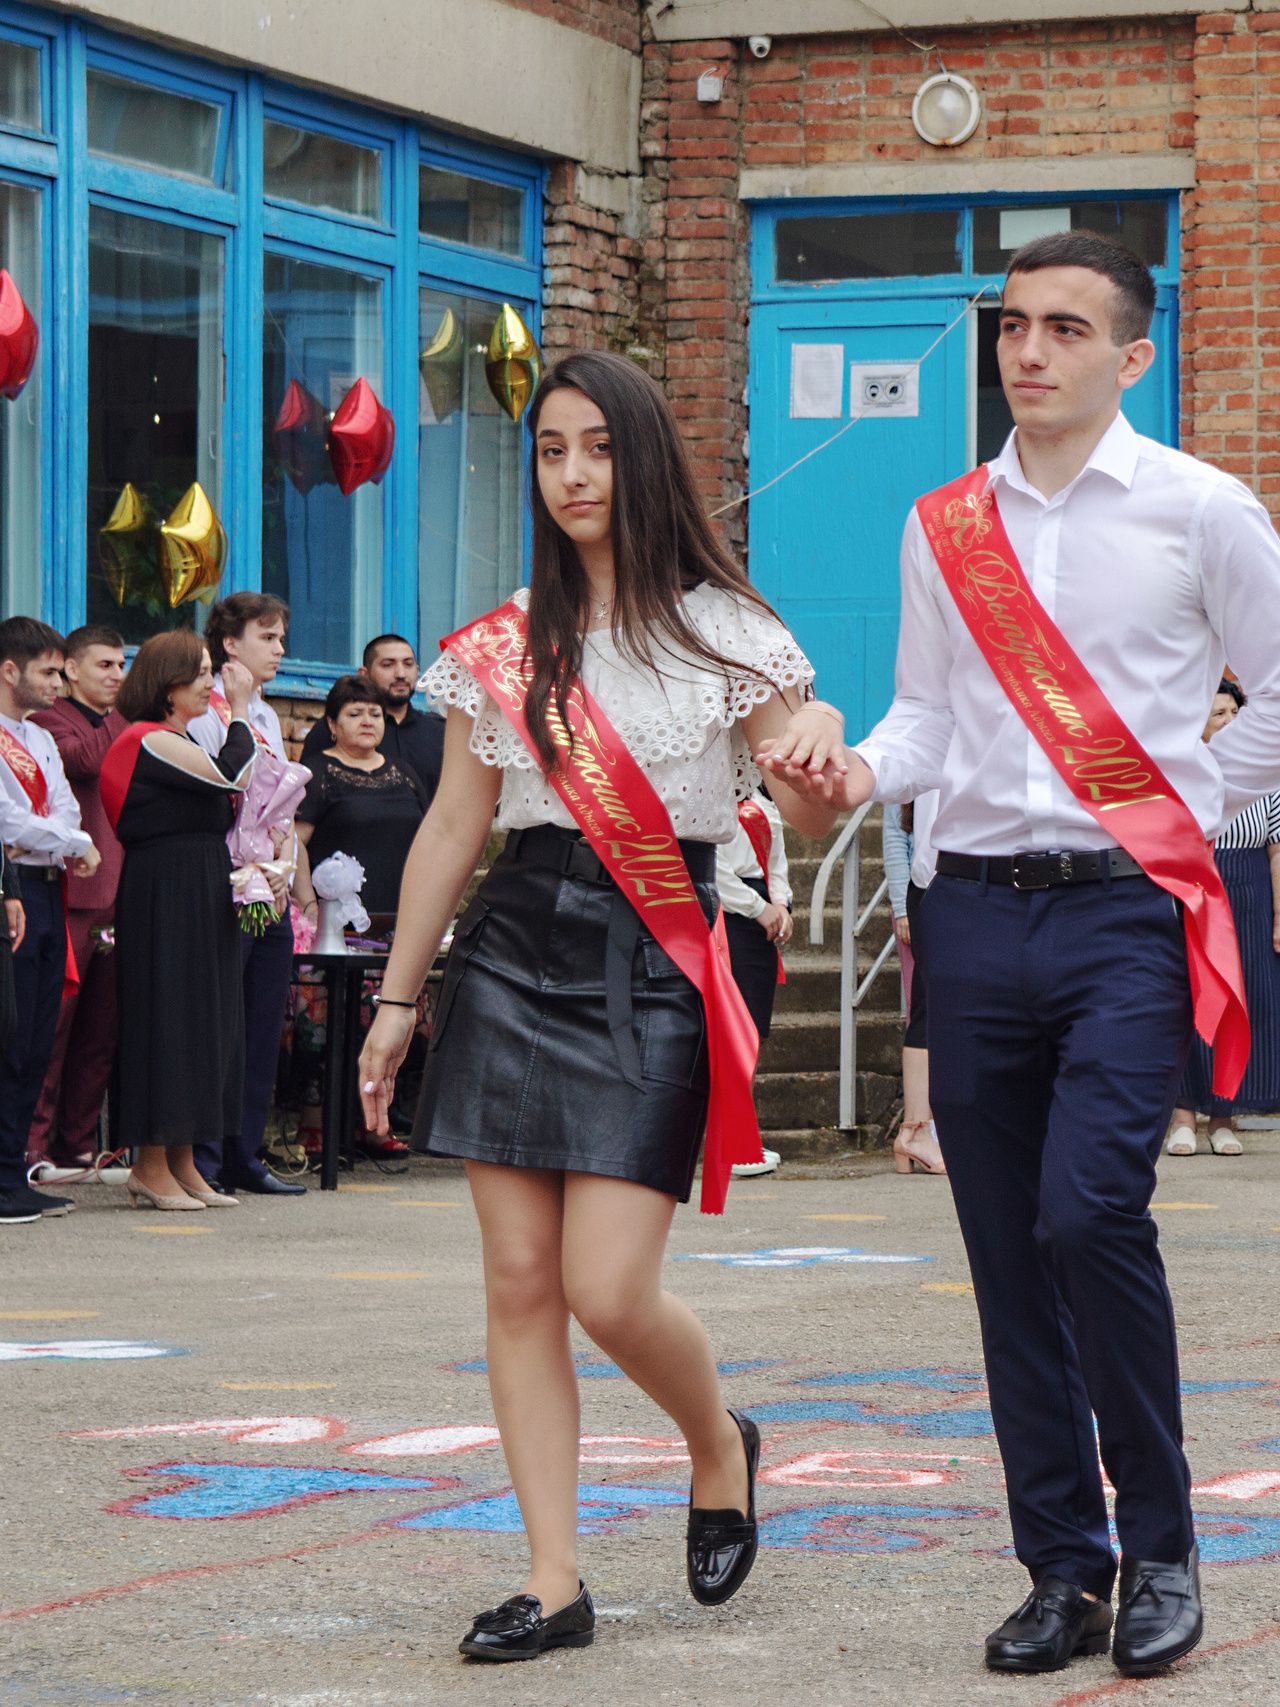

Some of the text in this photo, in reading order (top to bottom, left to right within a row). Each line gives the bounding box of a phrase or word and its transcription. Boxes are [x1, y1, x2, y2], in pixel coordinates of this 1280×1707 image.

[962, 550, 1167, 812] Выпускник 2021
[994, 655, 1056, 743] Республика Адыгея
[574, 803, 604, 837] Адыгея
[602, 834, 699, 908] 2021
